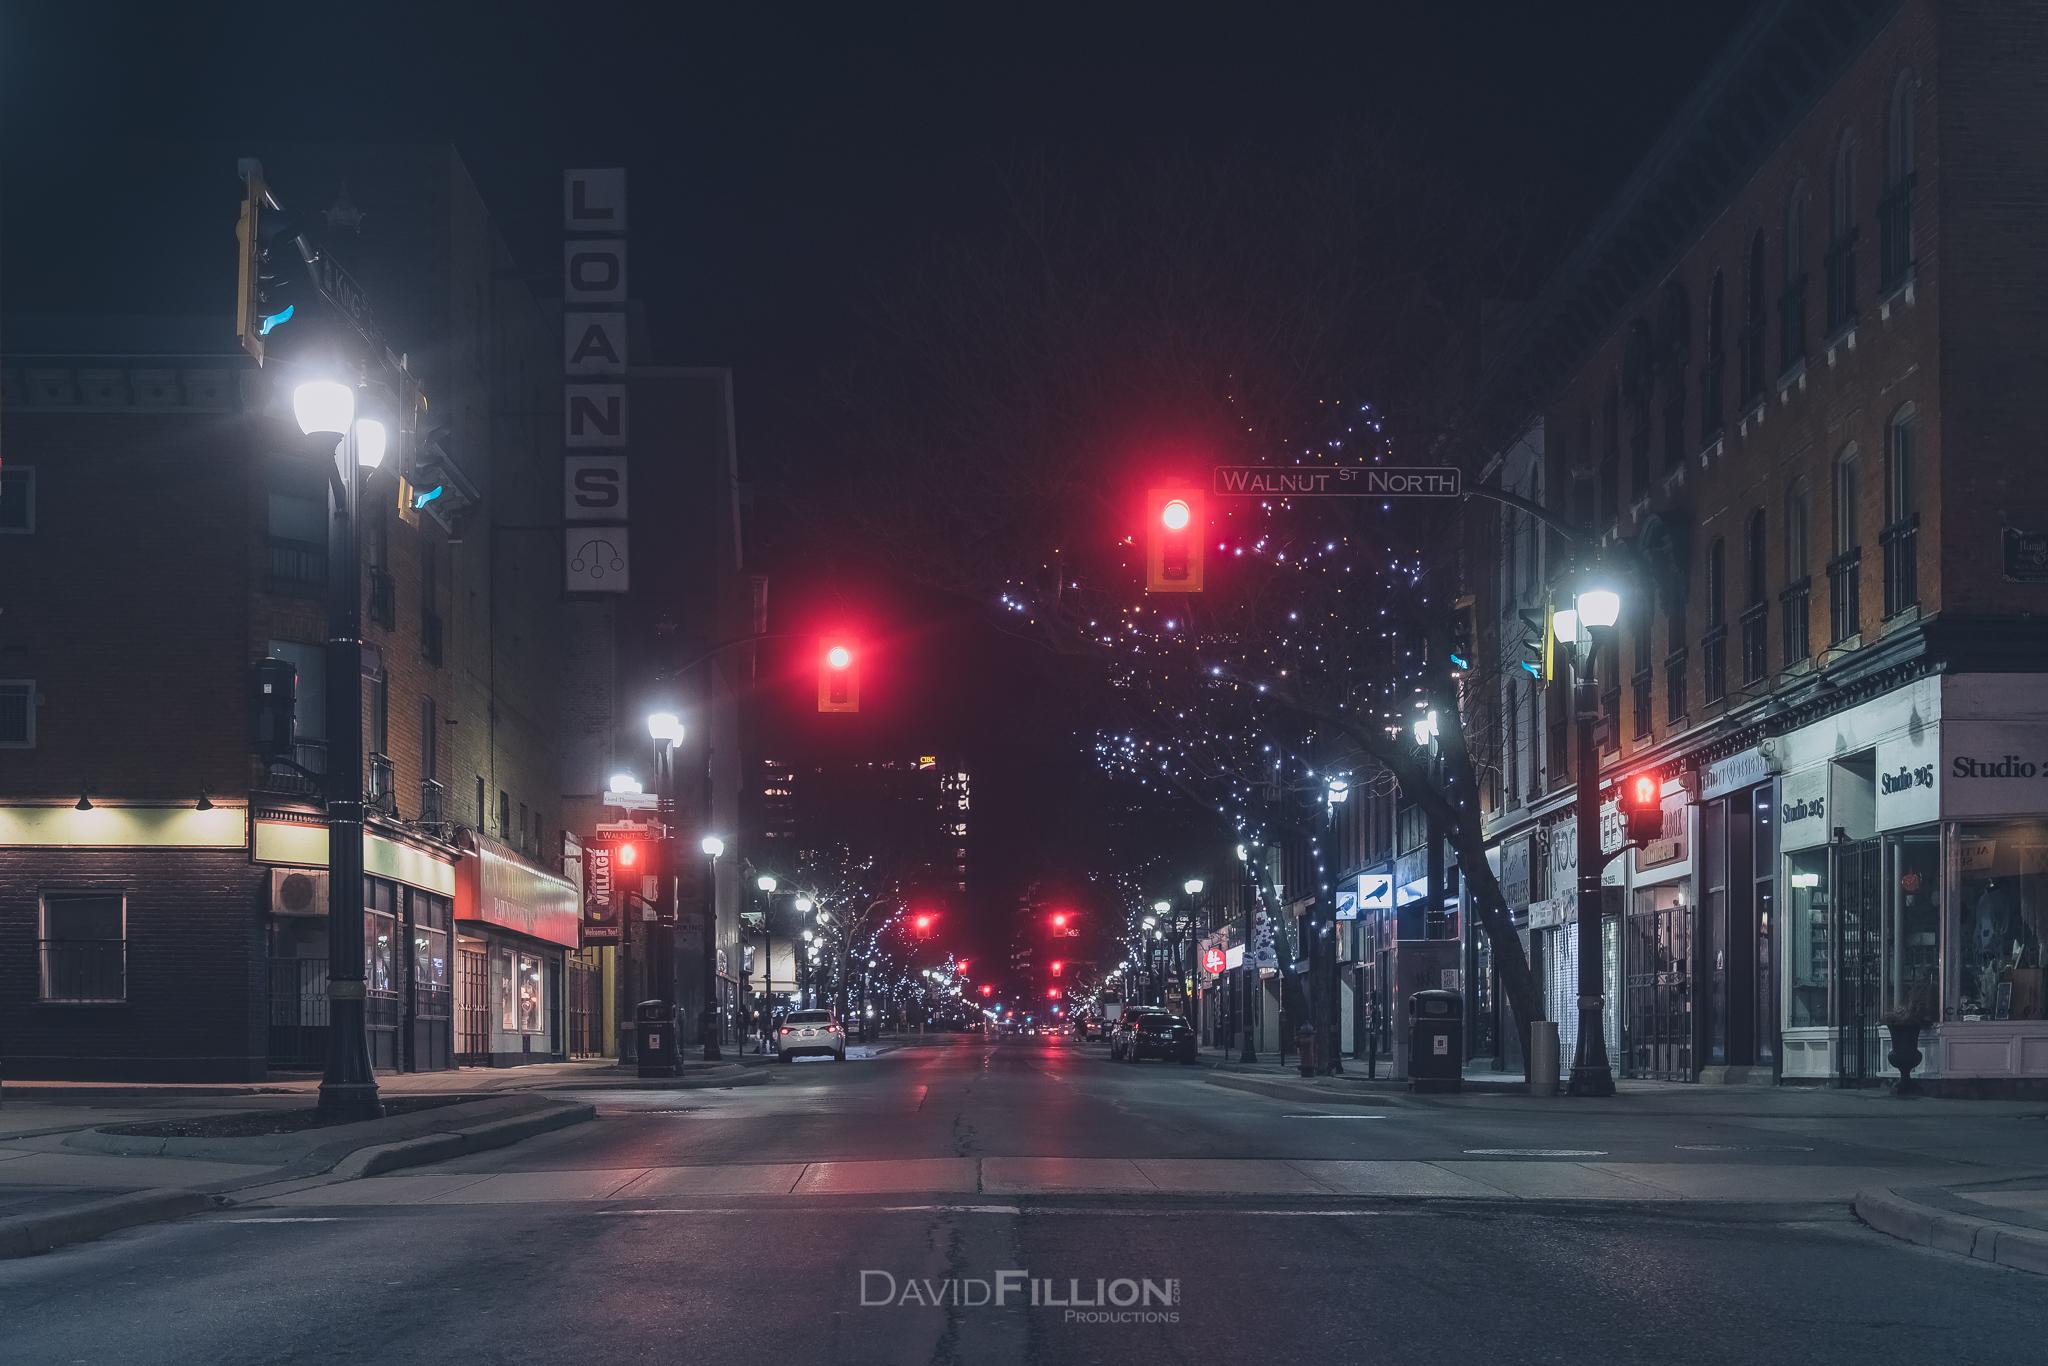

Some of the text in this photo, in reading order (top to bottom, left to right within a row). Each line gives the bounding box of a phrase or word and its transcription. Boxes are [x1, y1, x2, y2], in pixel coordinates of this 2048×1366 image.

[569, 180, 621, 508] LOANS
[1222, 471, 1329, 492] WALNUT
[1368, 471, 1455, 492] NORTH
[1881, 763, 1934, 796] Studio 205
[1952, 755, 2037, 778] Studio
[1782, 796, 1825, 824] Studio 205
[602, 831, 637, 840] WALNUT
[597, 849, 609, 905] VILLAGE
